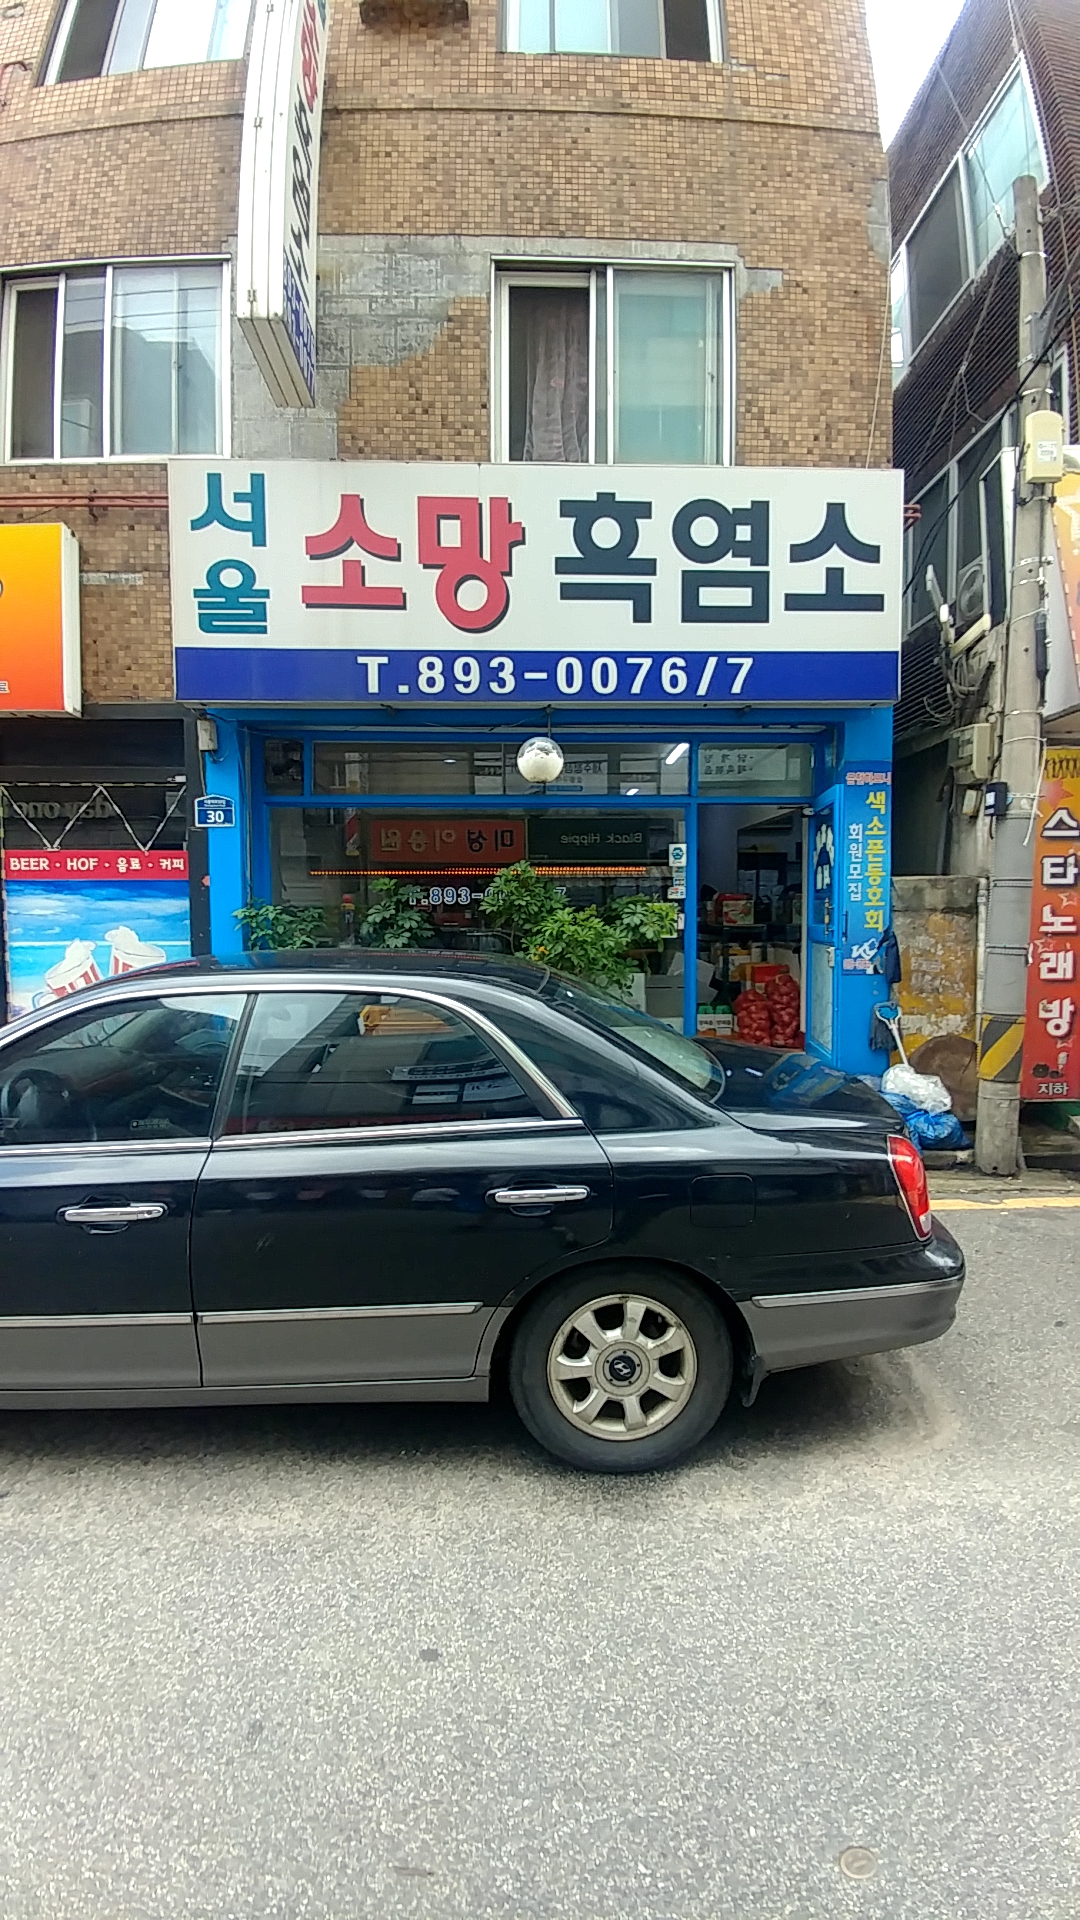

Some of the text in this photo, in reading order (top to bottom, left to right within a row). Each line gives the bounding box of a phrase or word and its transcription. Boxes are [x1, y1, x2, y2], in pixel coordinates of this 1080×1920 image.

[289, 84, 313, 308] 흑염소
[190, 472, 885, 634] 서울 소망 흑염소
[357, 656, 754, 696] T.893-0076/7
[206, 810, 225, 823] 30
[9, 857, 50, 871] BEER
[66, 857, 99, 871] HOF
[159, 857, 185, 871] 커피
[1038, 1082, 1069, 1096] 지하
